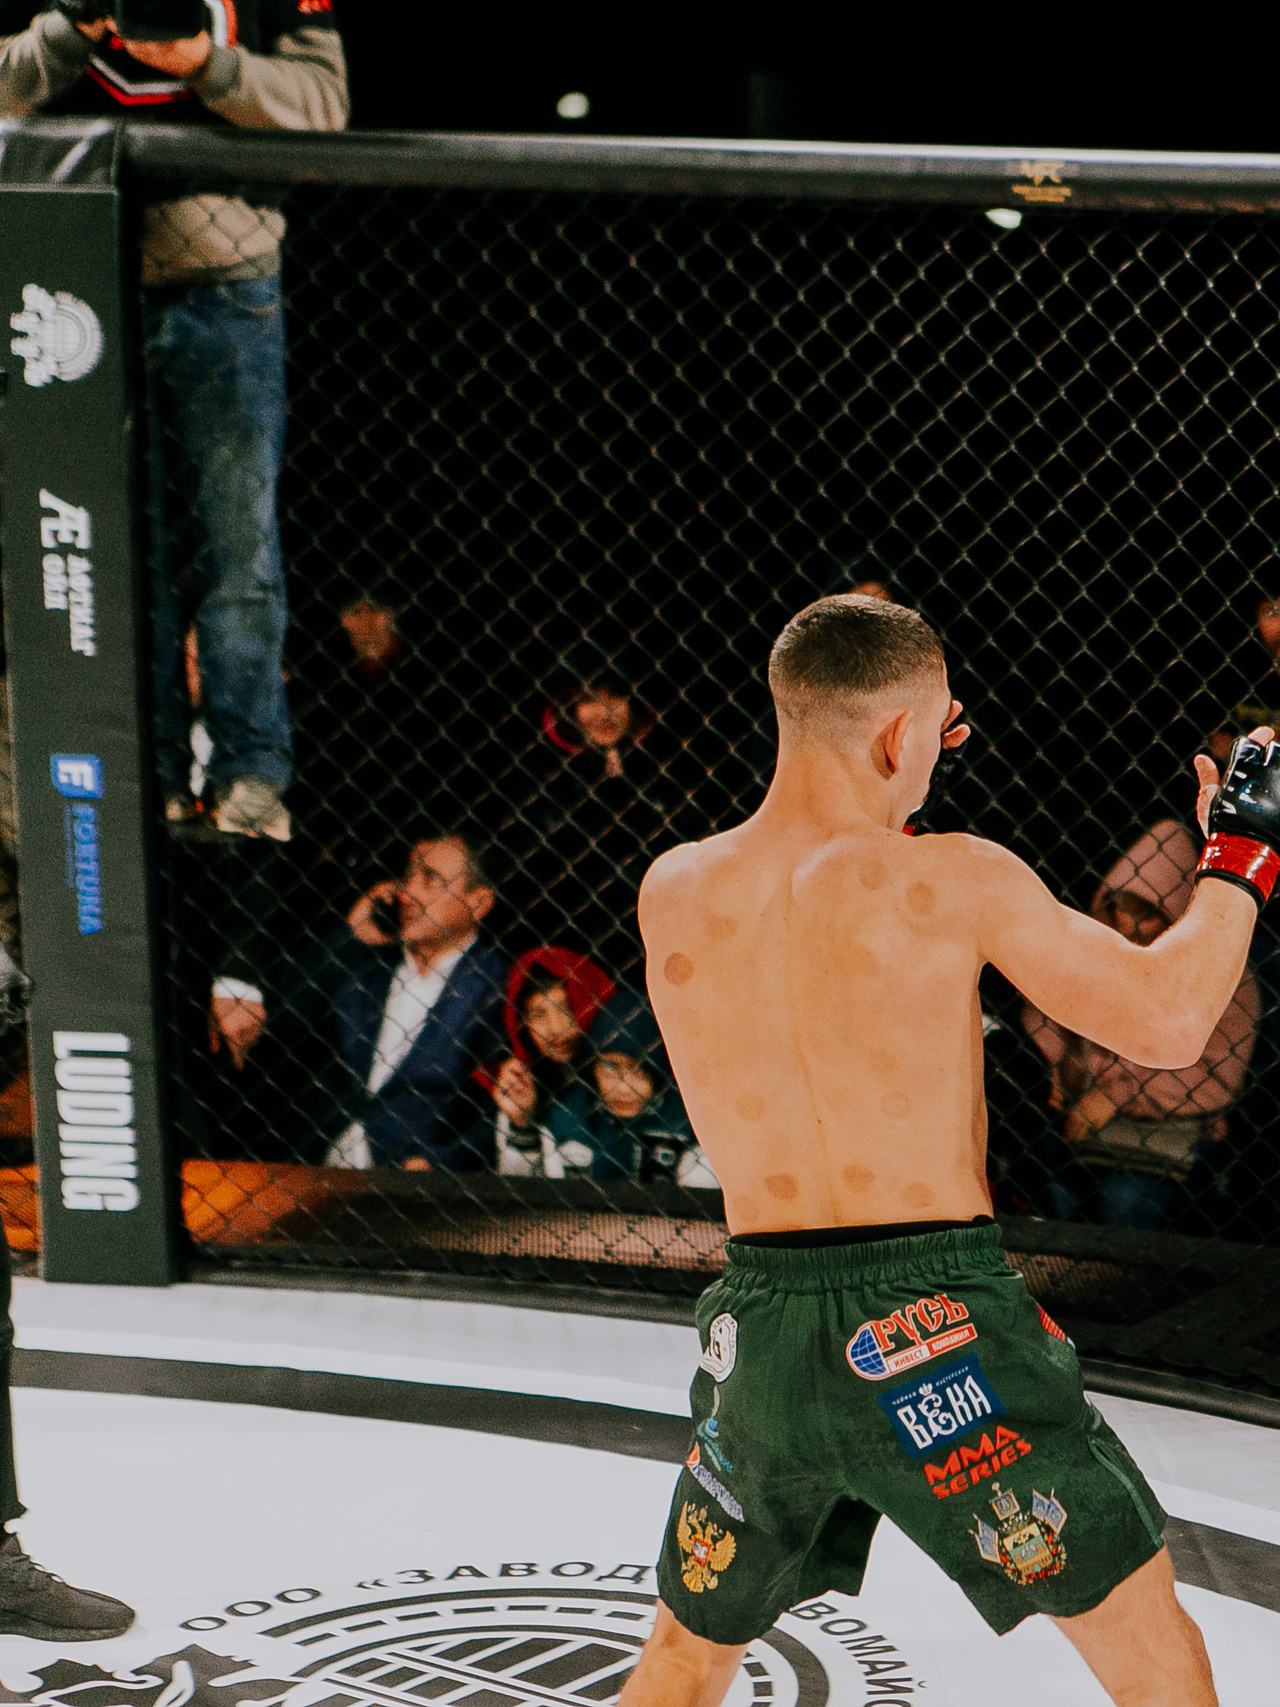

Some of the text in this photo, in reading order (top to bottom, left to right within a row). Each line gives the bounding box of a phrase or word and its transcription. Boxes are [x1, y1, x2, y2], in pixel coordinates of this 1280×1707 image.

[75, 804, 103, 936] FORTUNA
[52, 1029, 139, 1211] LUDING
[871, 1293, 970, 1353] РУСЬ
[893, 1349, 925, 1368] ИНВЕСТ
[896, 1374, 992, 1450] ВЕКА
[923, 1425, 1020, 1486] MMA
[932, 1438, 1032, 1499] SERIES
[179, 1587, 323, 1632] ООО
